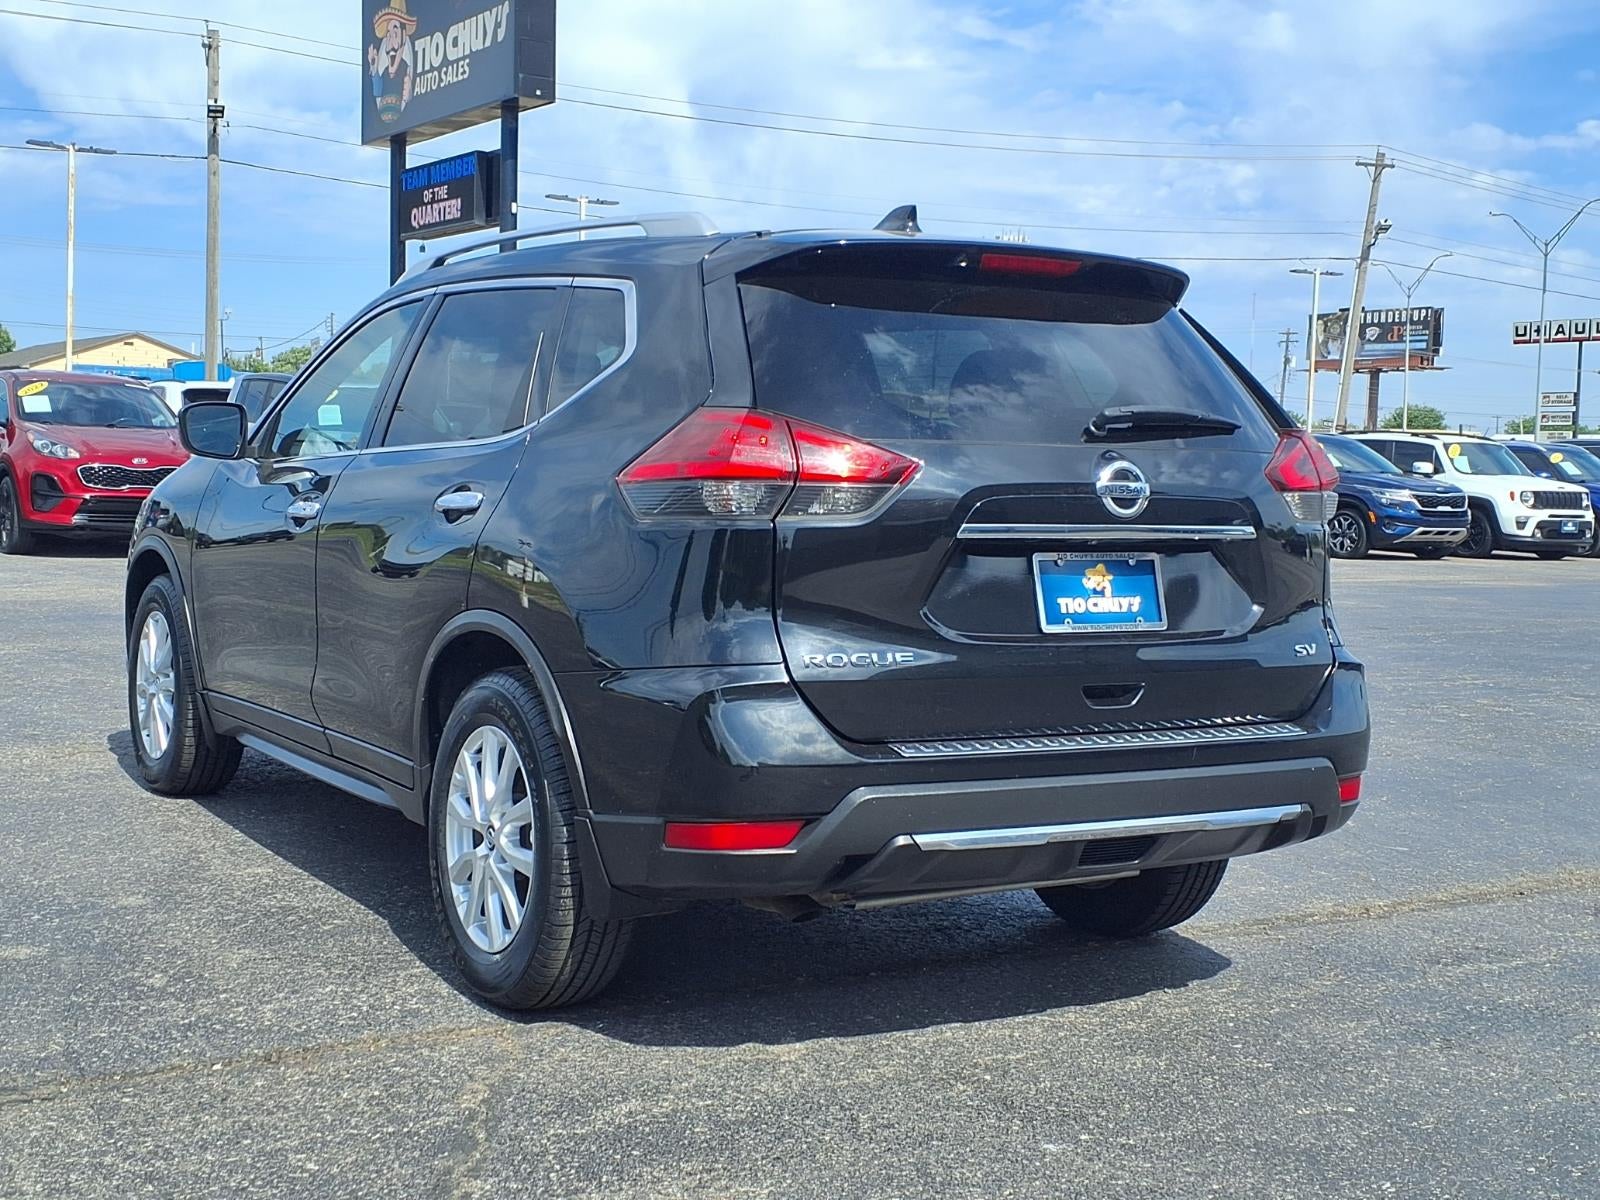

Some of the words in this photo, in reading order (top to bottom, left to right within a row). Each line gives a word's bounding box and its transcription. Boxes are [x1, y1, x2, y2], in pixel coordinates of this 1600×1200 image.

[414, 31, 445, 74] TIO
[446, 0, 510, 61] CHUY'S
[413, 70, 439, 97] AUTO
[440, 58, 470, 88] SALES
[401, 167, 428, 192] TEAM
[431, 154, 476, 185] MEMBER
[423, 188, 434, 204] OF
[434, 184, 449, 201] THE
[410, 197, 462, 229] QUARTER!
[1360, 310, 1407, 324] THUNDER
[1413, 308, 1432, 321] UP!
[1103, 485, 1148, 496] NISSAN
[1095, 552, 1115, 560] AUTO
[1056, 596, 1087, 614] TIO
[1086, 595, 1142, 613] CHUY'S
[1294, 643, 1317, 657] SV
[802, 651, 915, 669] ROGUE
